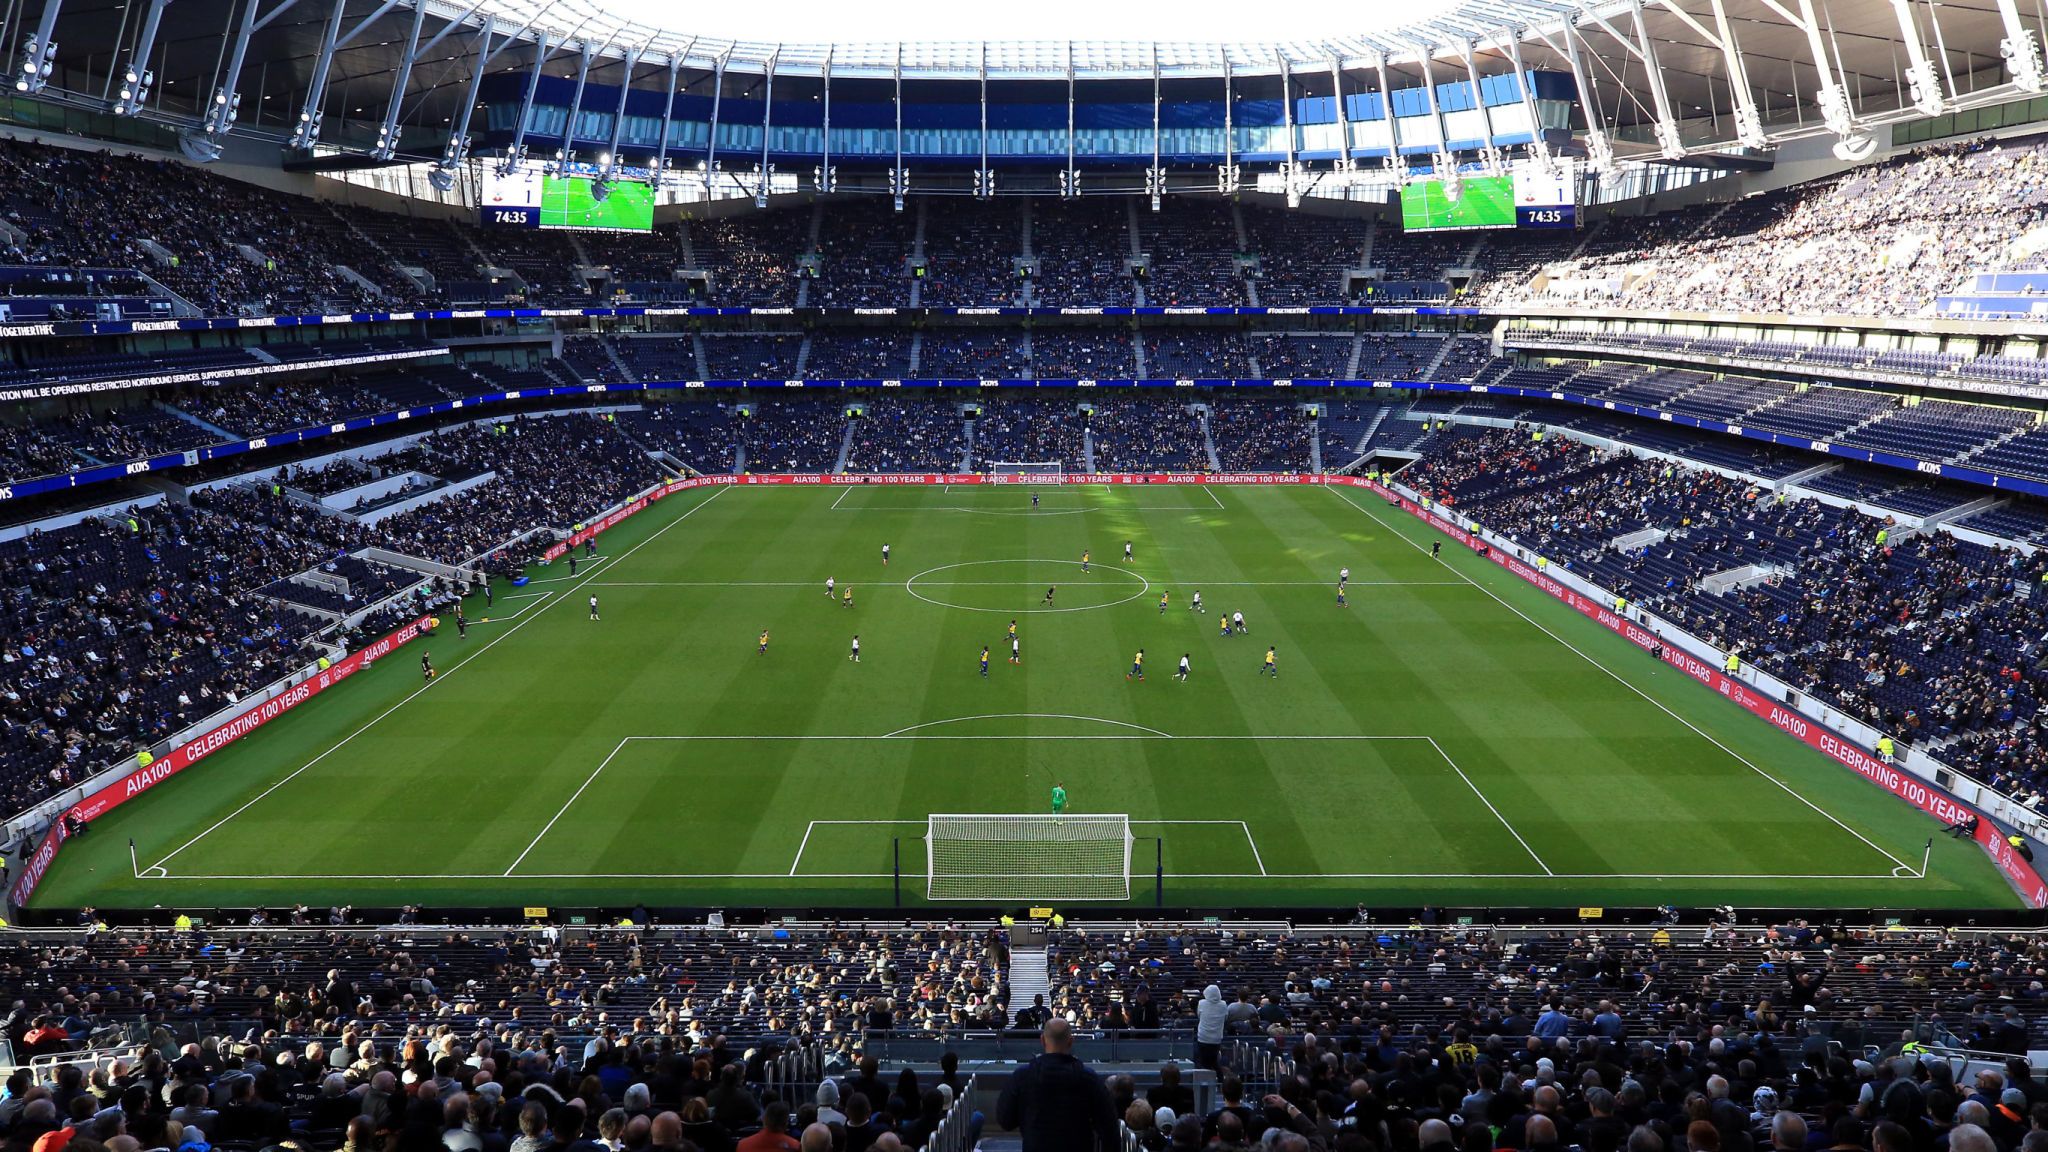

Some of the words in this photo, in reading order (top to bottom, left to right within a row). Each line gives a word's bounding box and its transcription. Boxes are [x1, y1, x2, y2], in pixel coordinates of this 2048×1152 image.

[527, 190, 531, 204] 1
[1558, 188, 1562, 202] 1
[496, 211, 527, 223] 74:35
[1529, 211, 1561, 222] 74:35
[132, 320, 180, 331] #TOGETHERTHFC
[21, 389, 40, 398] WILL
[40, 388, 51, 396] BE
[51, 384, 91, 396] OPERATING
[92, 380, 131, 391] RESTRICTED
[132, 376, 172, 387] NORTHBOUND
[201, 369, 234, 379] SUPPORTERS
[235, 367, 262, 376] TRAVELLING
[1852, 371, 1886, 382] RESTRICTED
[1887, 373, 1928, 386] NORTHBOUND
[1962, 381, 2009, 394] SUPPORTERS
[250, 438, 267, 449] #COYS
[127, 461, 150, 474] #COYS
[1917, 461, 1942, 475] #COYS
[699, 477, 711, 485] 100
[711, 476, 738, 484] YEARS
[1509, 559, 1537, 584] CELEBRATING
[1546, 579, 1562, 598] YEARS
[364, 639, 390, 662] AIA100
[1598, 610, 1620, 630] AIA100
[1671, 651, 1684, 667] 100
[1685, 659, 1711, 683] YEARS
[127, 759, 172, 796] AIA100
[187, 712, 259, 762] CELEBRATING
[260, 701, 278, 722] 100
[279, 684, 310, 710] YEARS
[1770, 707, 1807, 738] AIA100
[1819, 735, 1899, 790] CELEBRATING
[1902, 780, 1926, 804] 100
[22, 870, 34, 898] 100
[32, 840, 52, 880] YEARS
